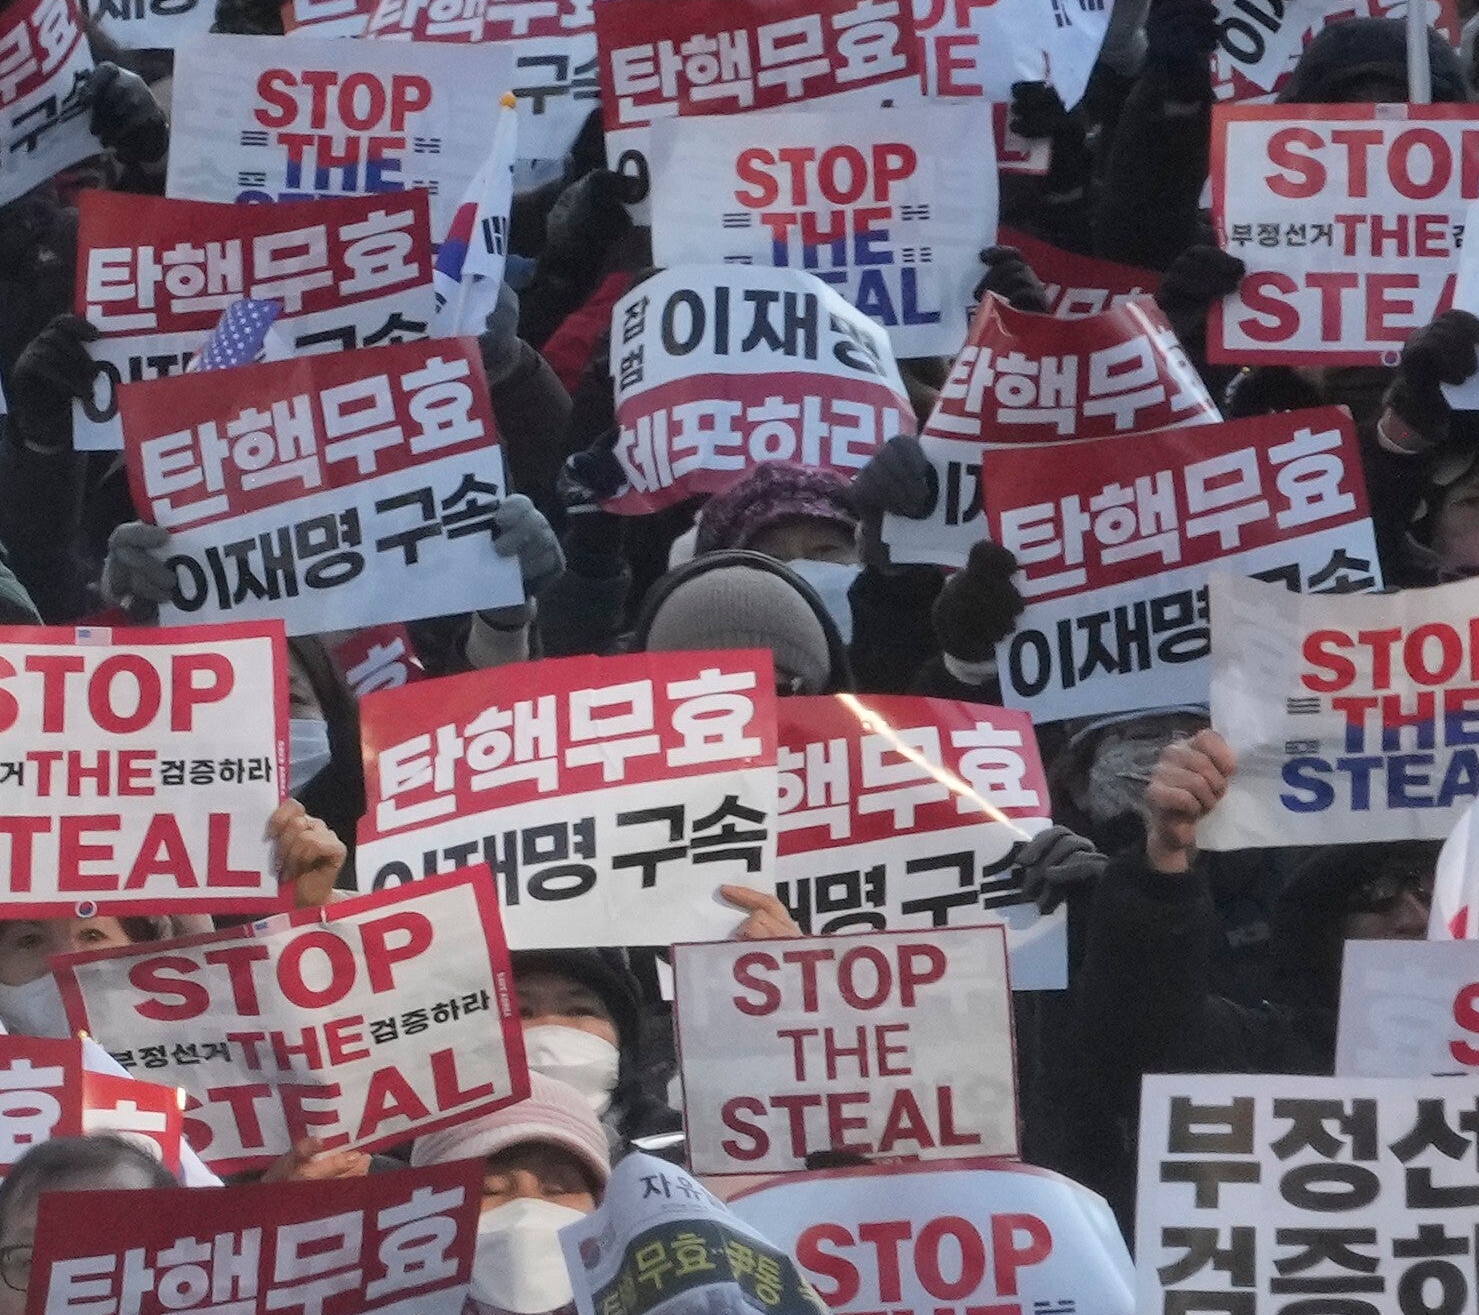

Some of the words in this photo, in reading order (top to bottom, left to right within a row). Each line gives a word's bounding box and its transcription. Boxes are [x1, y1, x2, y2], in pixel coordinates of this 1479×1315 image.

[609, 0, 908, 131] 탄핵무효
[254, 69, 433, 131] STOP
[277, 133, 406, 193] THE
[734, 143, 916, 207] STOP
[750, 209, 890, 268] THE
[1231, 223, 1334, 248] 부정선거
[1335, 215, 1449, 258] THE
[142, 360, 483, 518] 탄핵무효
[1001, 426, 1359, 586] 탄핵무효
[26, 750, 154, 798] THE
[160, 755, 272, 786] 검증하라
[375, 671, 758, 834] 탄핵무효
[133, 908, 436, 1021] STOP
[730, 946, 947, 1017] STOP
[230, 1017, 371, 1075] THE
[369, 989, 490, 1043] 검증하라
[777, 1025, 910, 1080] THE
